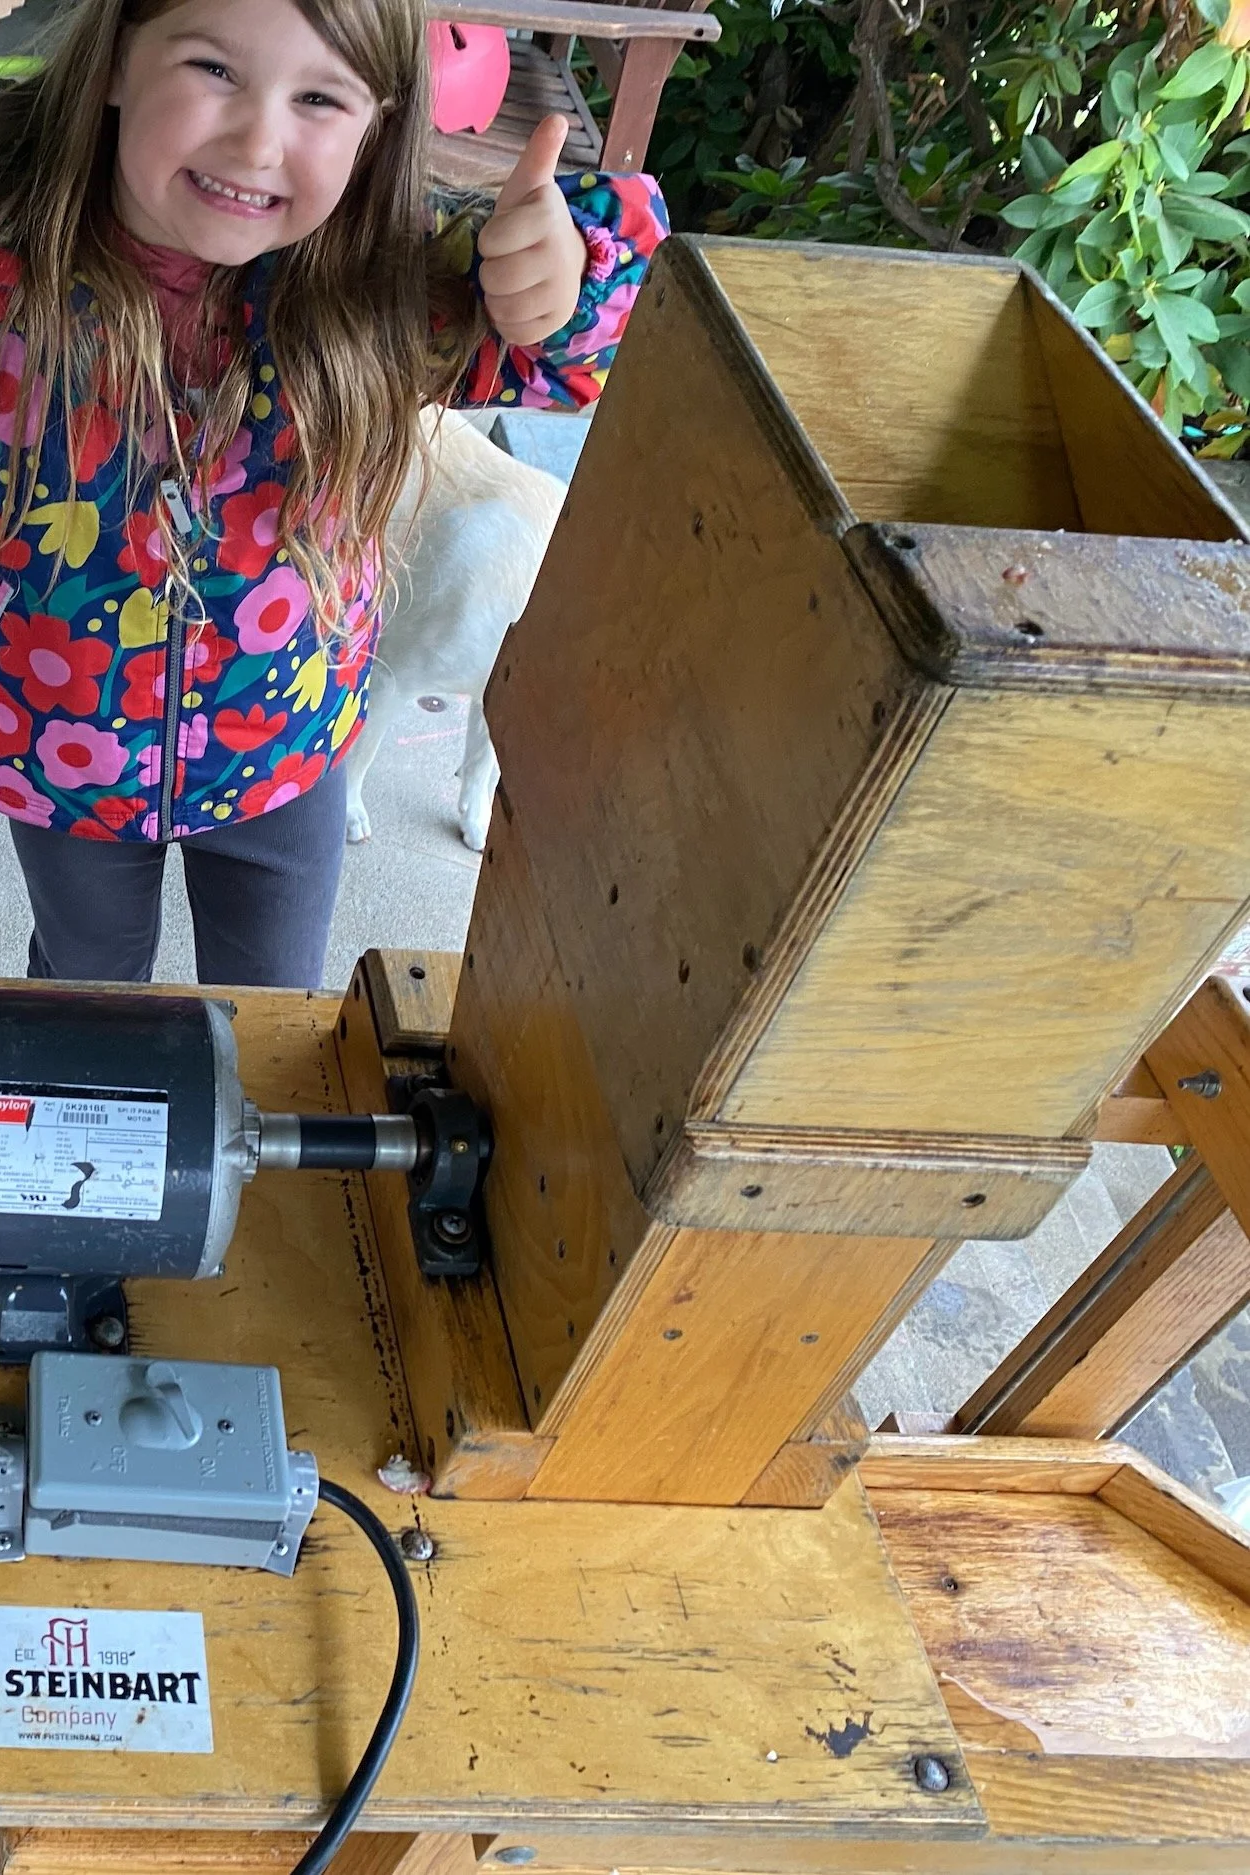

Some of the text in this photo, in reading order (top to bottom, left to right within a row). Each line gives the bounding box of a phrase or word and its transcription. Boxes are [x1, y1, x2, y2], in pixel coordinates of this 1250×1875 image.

[97, 1650, 129, 1665] 1918
[5, 1669, 201, 1704] STEINBART
[21, 1705, 117, 1729] Company
